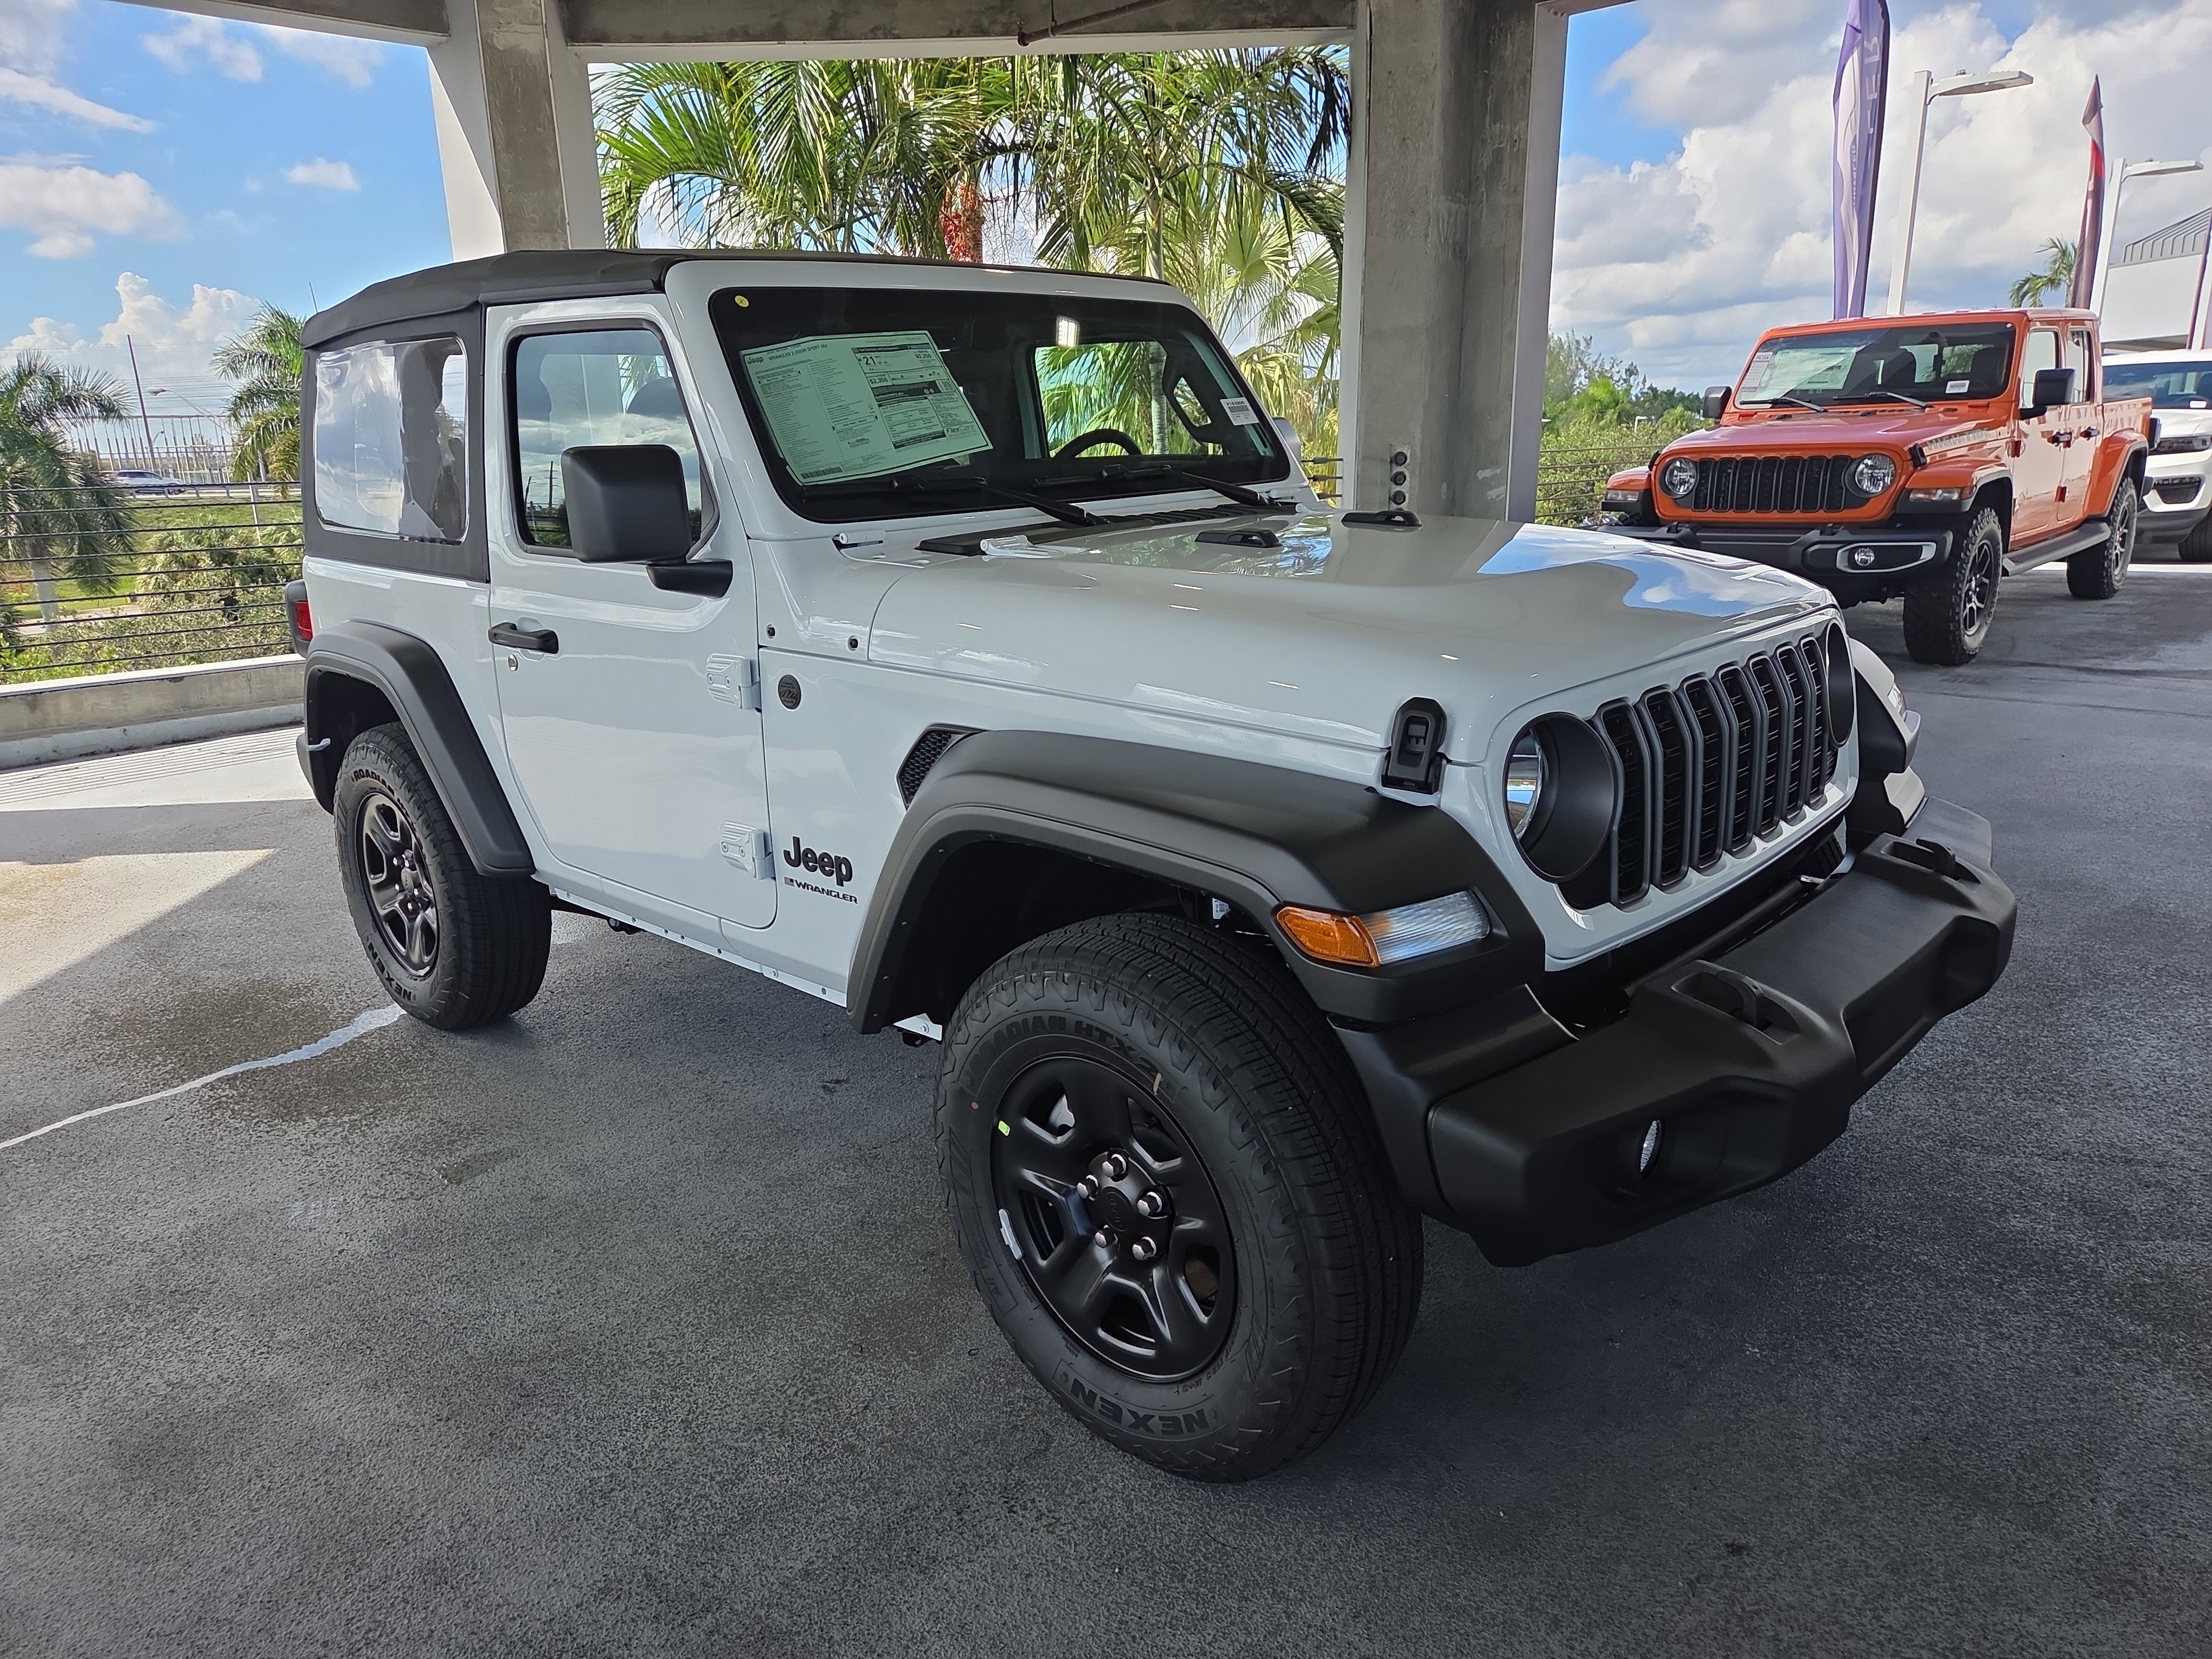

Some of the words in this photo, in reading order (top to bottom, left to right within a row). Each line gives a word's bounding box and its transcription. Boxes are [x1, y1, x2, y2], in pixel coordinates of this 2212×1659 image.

[747, 356, 764, 364] Jeep
[768, 351, 791, 361] WRANGLER
[863, 356, 877, 365] 21
[946, 425, 975, 434] FlexCare
[783, 835, 853, 887] Jeep
[794, 879, 858, 904] WRANGLER
[1071, 1377, 1210, 1435] NEXEN
